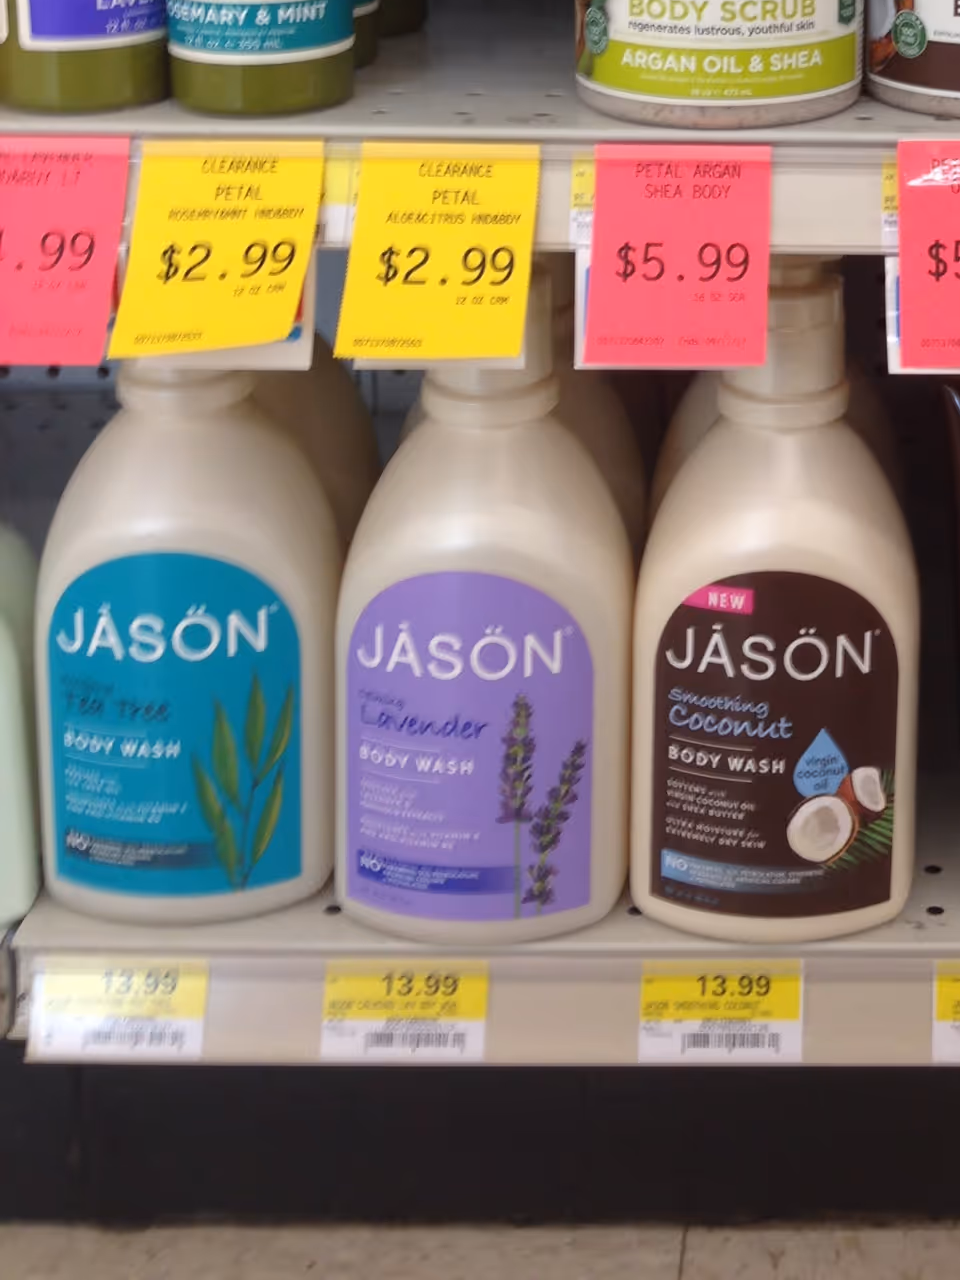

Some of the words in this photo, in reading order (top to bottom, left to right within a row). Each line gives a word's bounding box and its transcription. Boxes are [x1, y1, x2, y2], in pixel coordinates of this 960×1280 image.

[278, 1, 327, 24] MINT
[628, 20, 691, 35] regenerates
[748, 23, 793, 37] youthful
[795, 20, 815, 32] skin
[621, 49, 697, 73] ARGAN
[703, 55, 742, 74] OIL
[749, 55, 764, 72] &
[770, 49, 822, 69] SHEA
[418, 162, 493, 179] CLEARANCE
[635, 163, 683, 179] PETAL
[693, 163, 741, 179] ARGAN
[644, 183, 683, 199] SHEA
[692, 183, 731, 199] BODY
[156, 239, 297, 285] $2.99
[376, 244, 516, 288] $2.99
[615, 241, 750, 283] $5.99
[708, 591, 745, 610] NEW
[668, 687, 769, 718] Smoothing
[360, 703, 488, 740] Lavender
[669, 705, 793, 739] Coconut
[120, 739, 182, 759] WASH
[359, 744, 408, 769] BODY
[416, 755, 475, 776] WASH
[668, 745, 720, 769] BODY
[728, 755, 786, 775] WASH
[101, 969, 178, 995] 13.99
[381, 972, 459, 997] 13.99
[696, 975, 772, 997] 13.99
